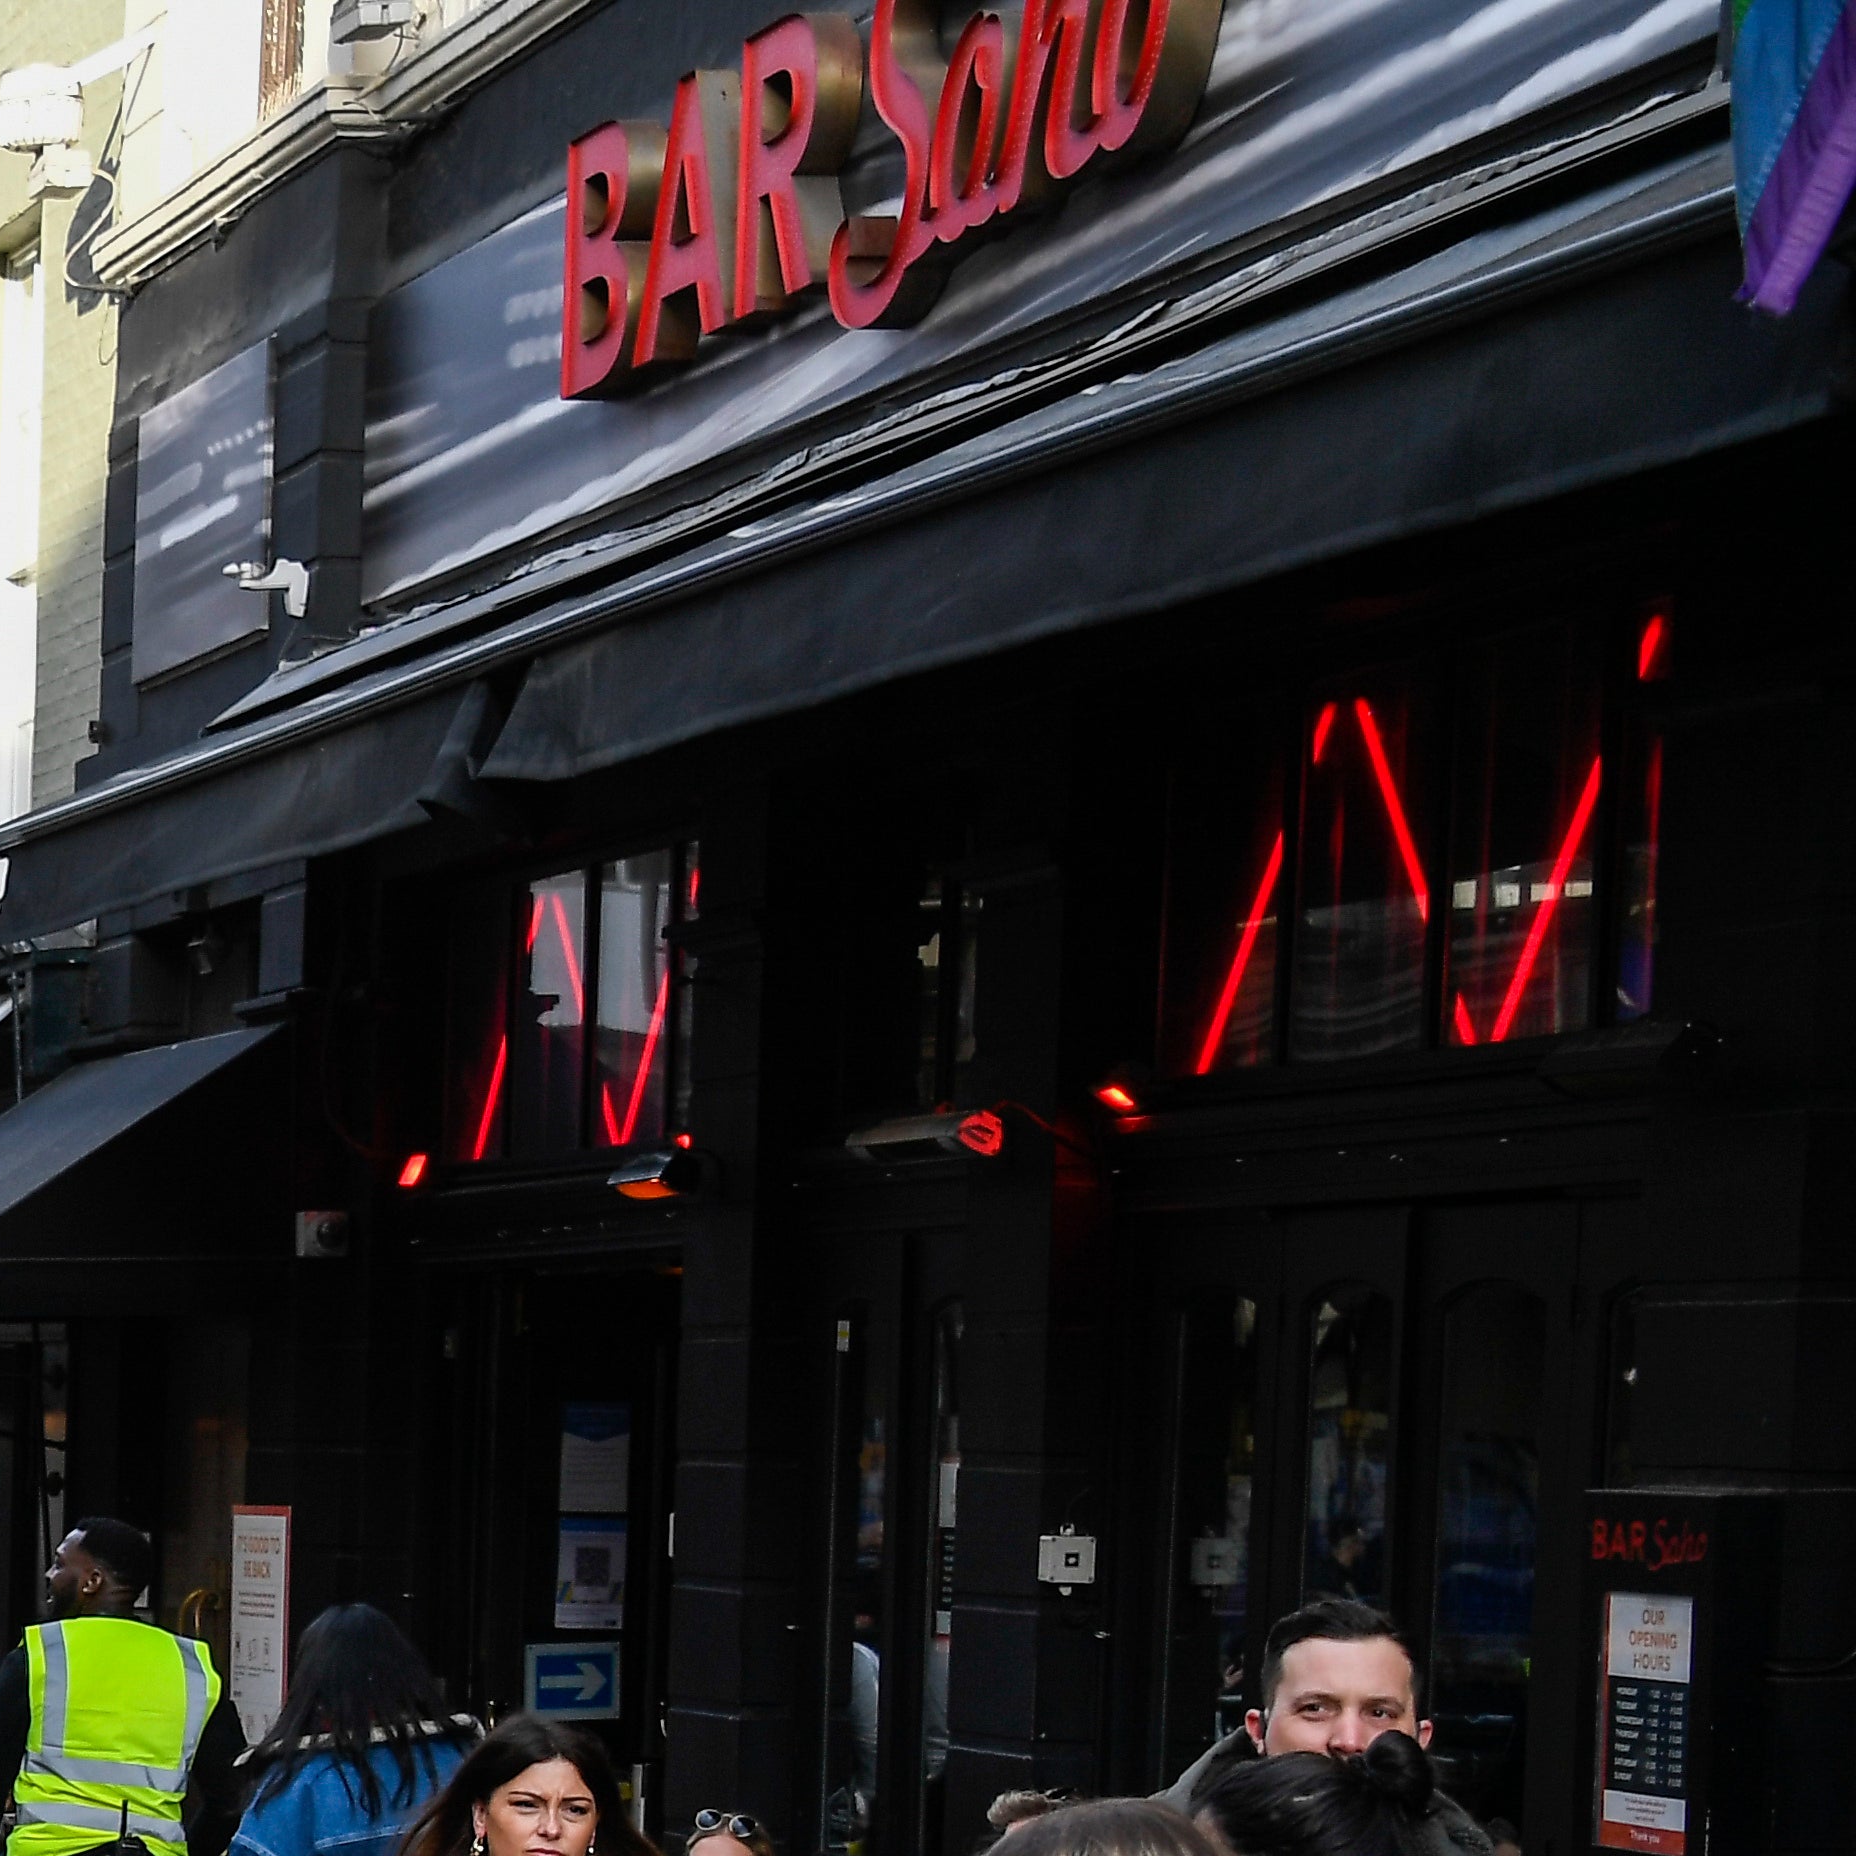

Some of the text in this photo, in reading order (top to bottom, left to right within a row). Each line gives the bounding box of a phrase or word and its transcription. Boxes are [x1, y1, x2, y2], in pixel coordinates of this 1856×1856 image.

[560, 13, 820, 400] BAR
[1591, 1519, 1647, 1561] BAR
[1642, 1609, 1665, 1625] OUR
[1628, 1630, 1678, 1650] OPENING
[1633, 1653, 1671, 1672] HOURS
